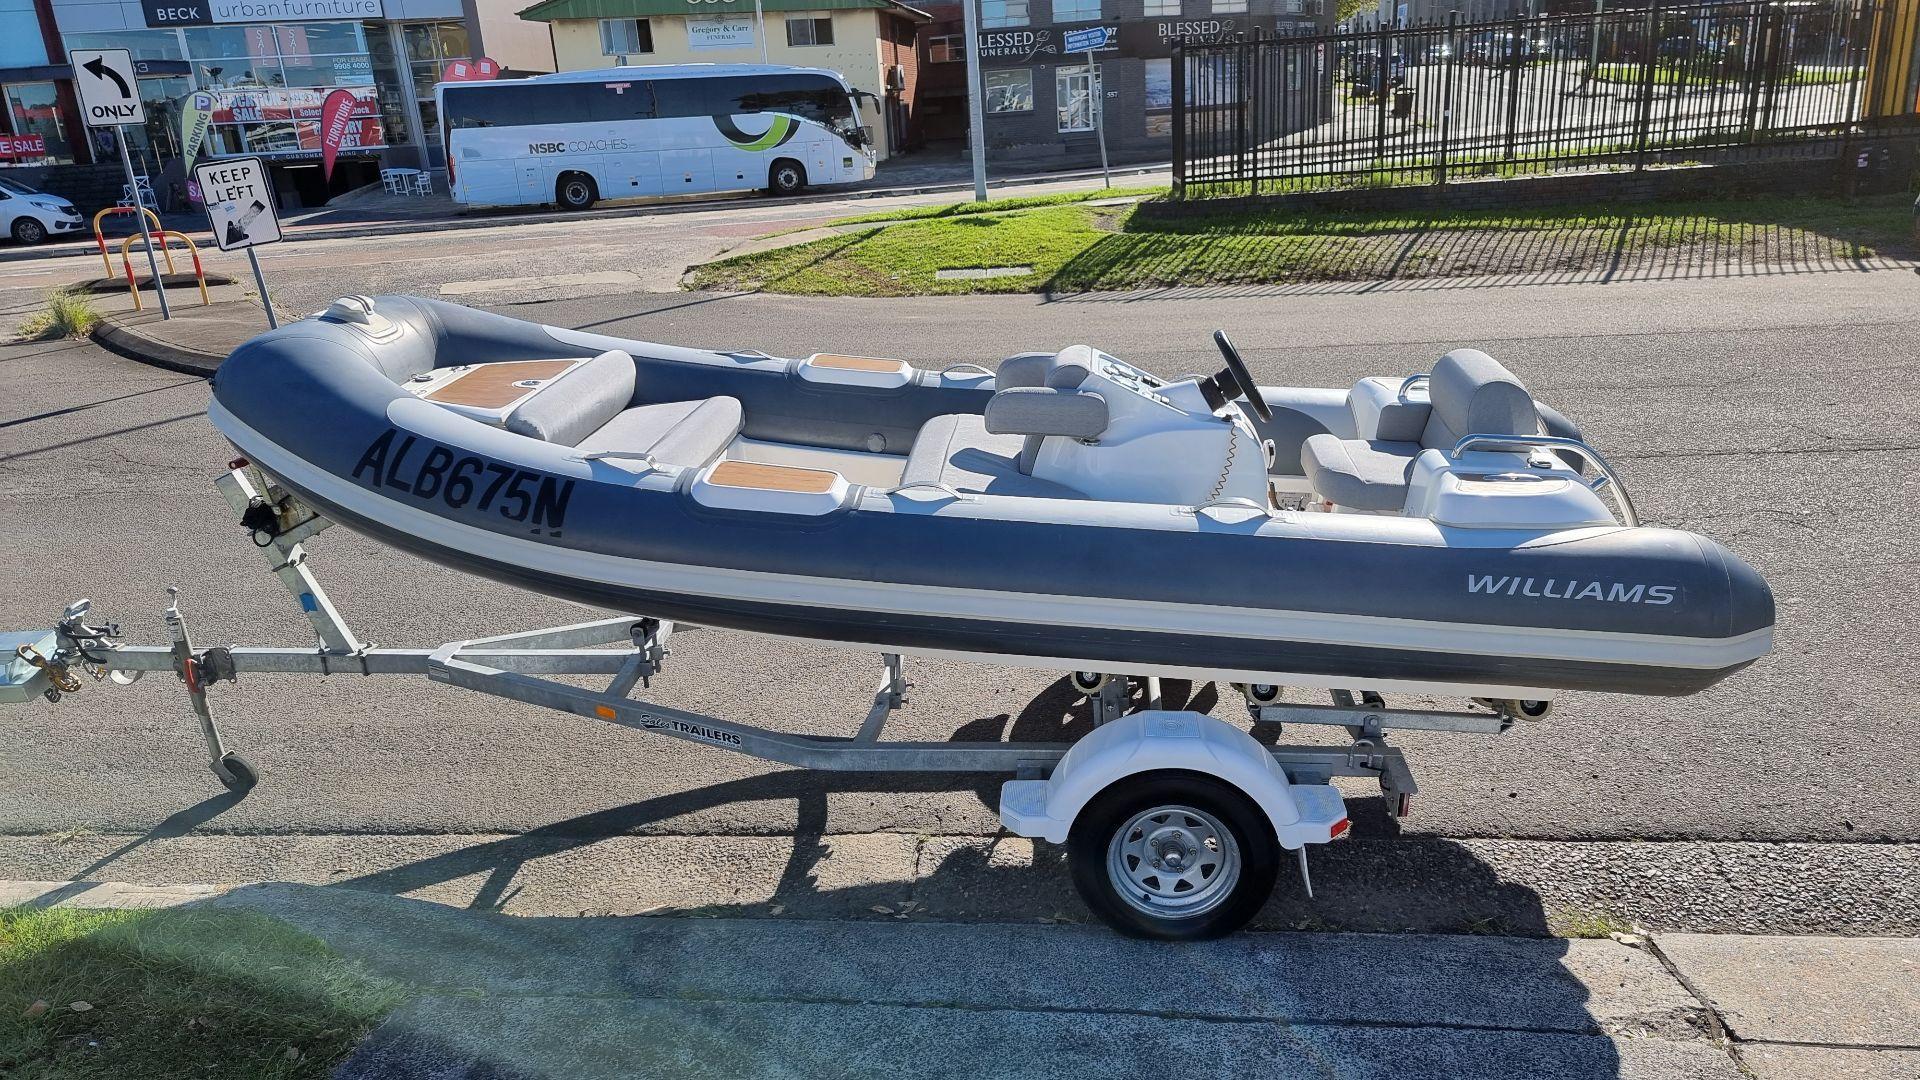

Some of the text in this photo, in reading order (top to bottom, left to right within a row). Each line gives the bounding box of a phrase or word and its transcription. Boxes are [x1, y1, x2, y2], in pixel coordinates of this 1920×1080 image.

[157, 8, 199, 21] BECK
[691, 26, 720, 34] Gregory
[732, 24, 749, 32] Carr
[1107, 27, 1118, 36] 97
[1158, 20, 1220, 36] BLESSED
[978, 31, 1034, 48] LESSED
[978, 46, 1031, 57] UNERALS
[92, 104, 136, 118] ONLY
[196, 97, 209, 109] P
[233, 107, 262, 122] SALE
[326, 98, 353, 148] FURNITURE
[186, 112, 209, 157] PARKING
[13, 140, 44, 152] SALE
[528, 138, 629, 155] NSBC COACHES
[208, 167, 251, 185] KEEP
[216, 185, 254, 203] LEFT
[352, 426, 576, 538] ALB675N
[1468, 574, 1677, 605] WILLIAMS
[671, 721, 741, 744] TRAILERS
